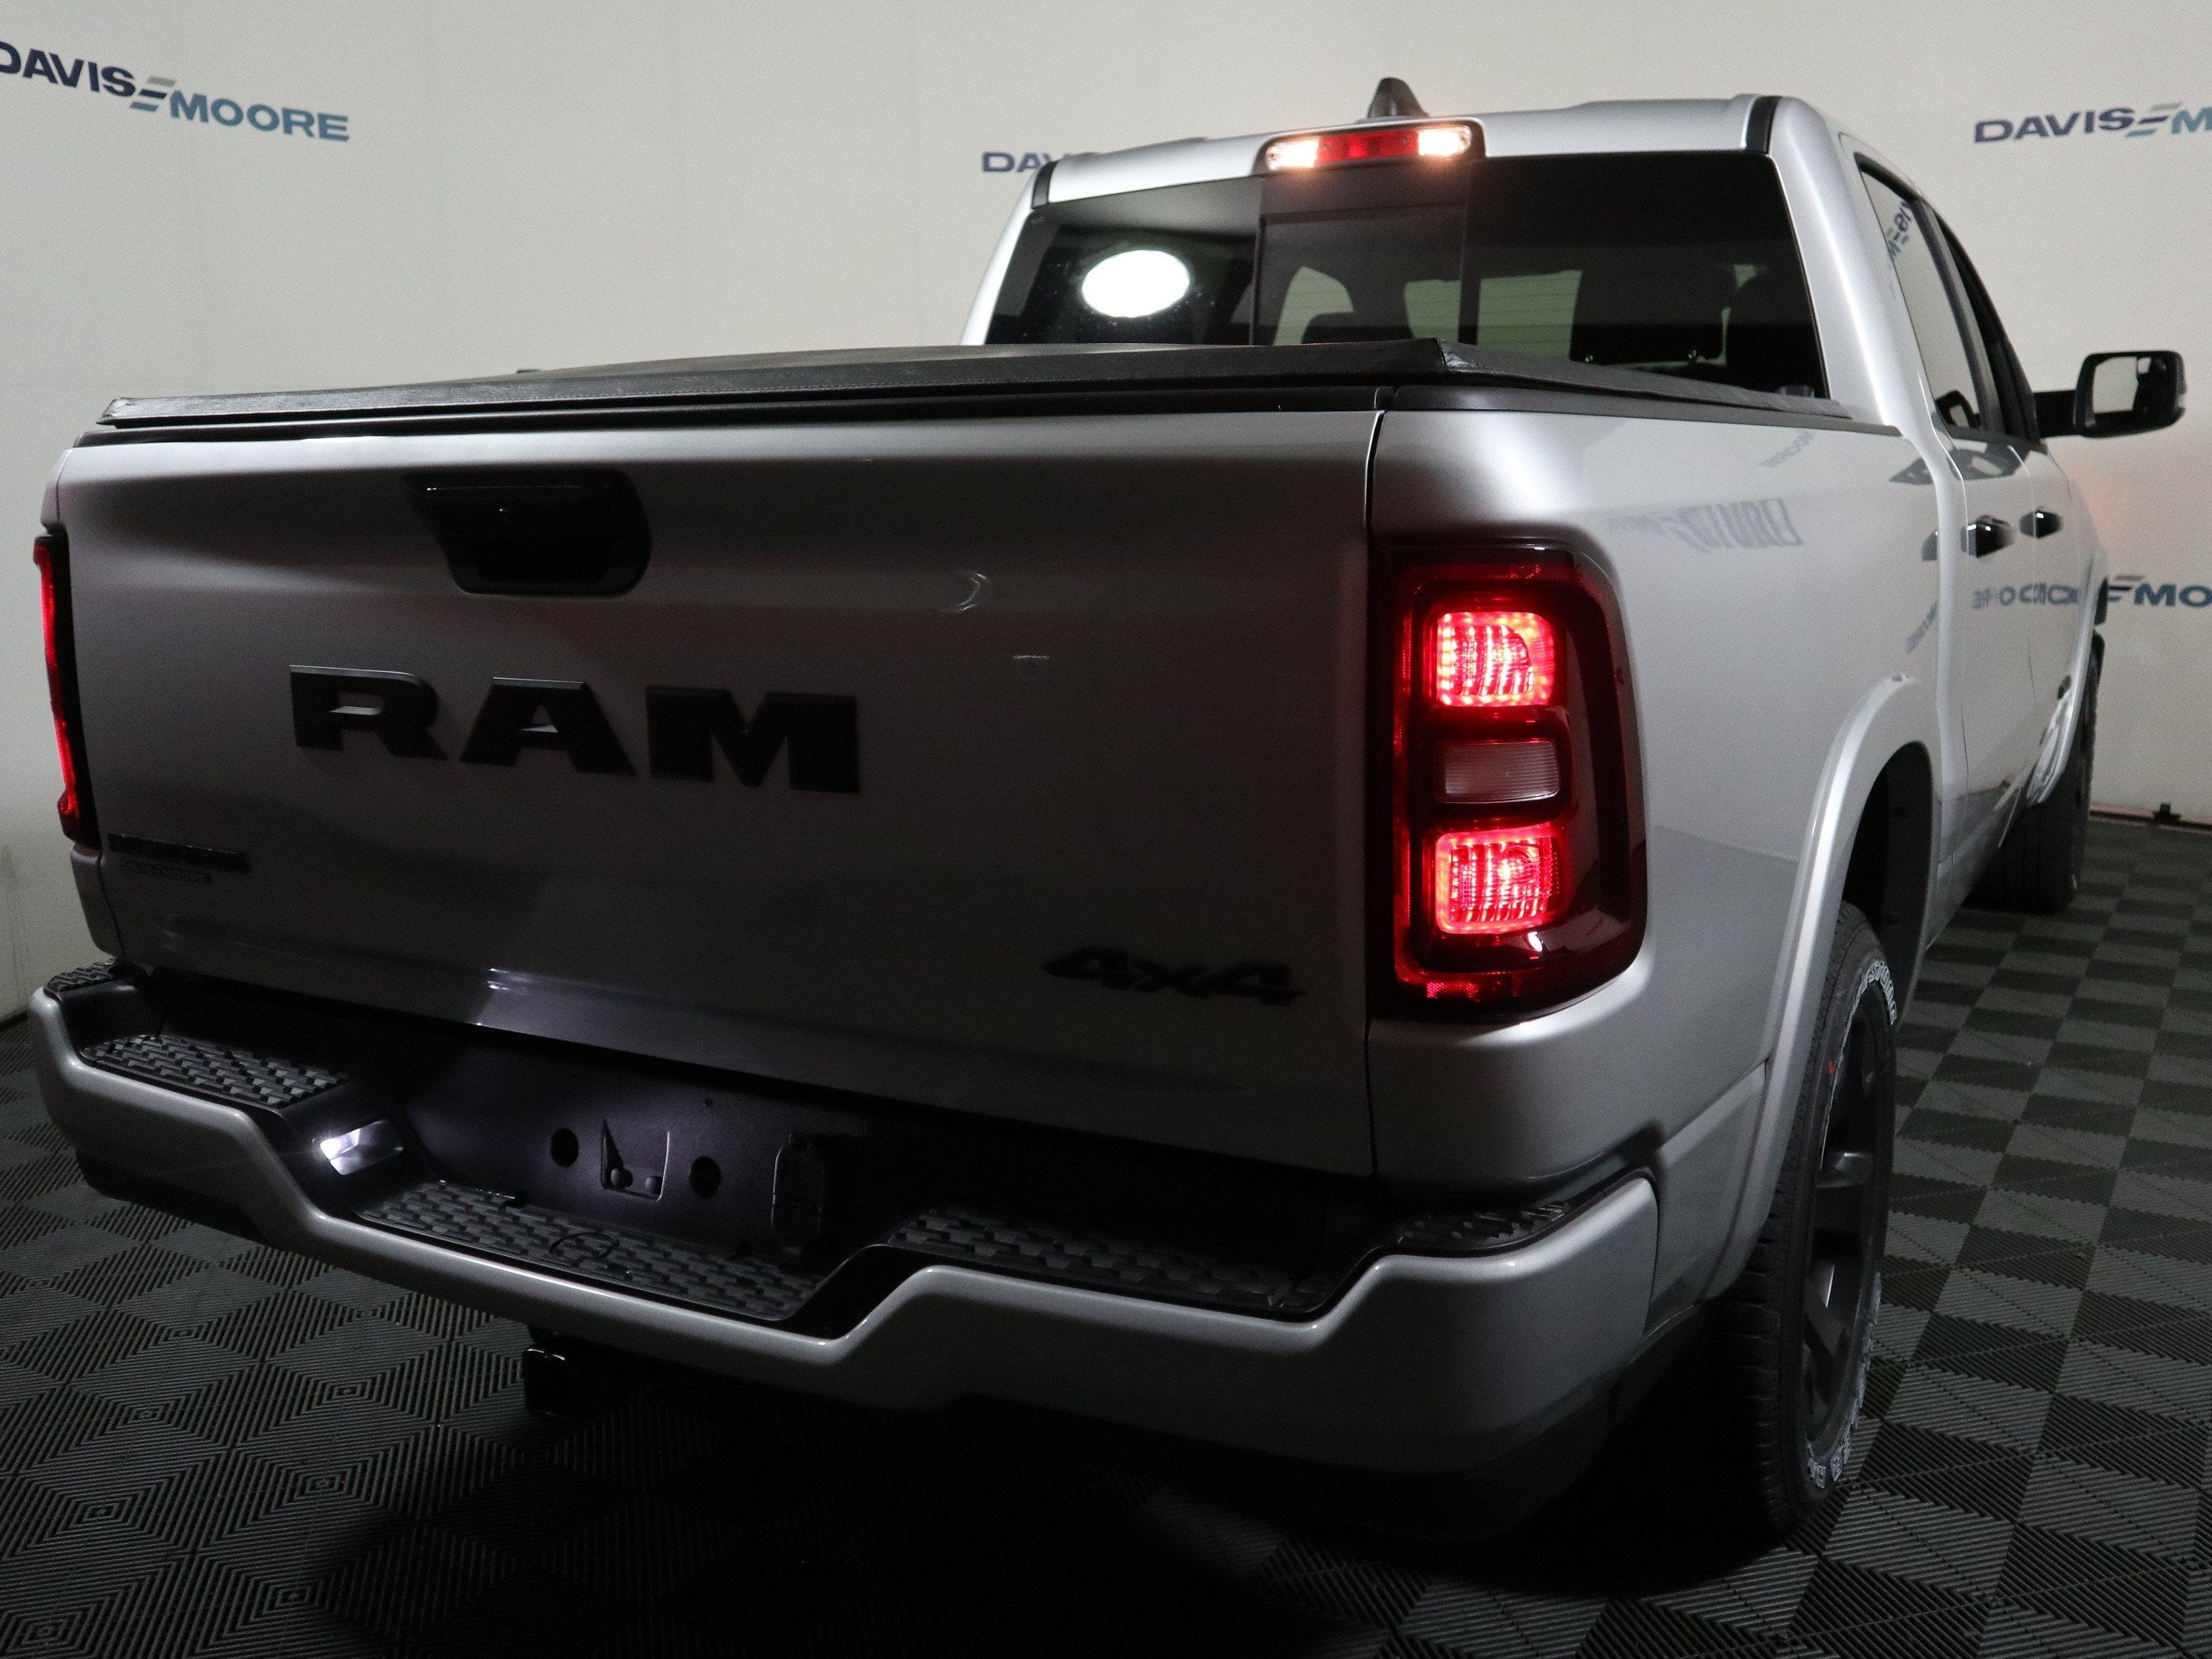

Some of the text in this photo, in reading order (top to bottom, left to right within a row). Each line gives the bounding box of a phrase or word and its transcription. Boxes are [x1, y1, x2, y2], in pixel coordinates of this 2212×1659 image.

[170, 90, 349, 142] MOORE
[1974, 107, 2135, 142] DAVIS
[289, 665, 861, 795] RAM
